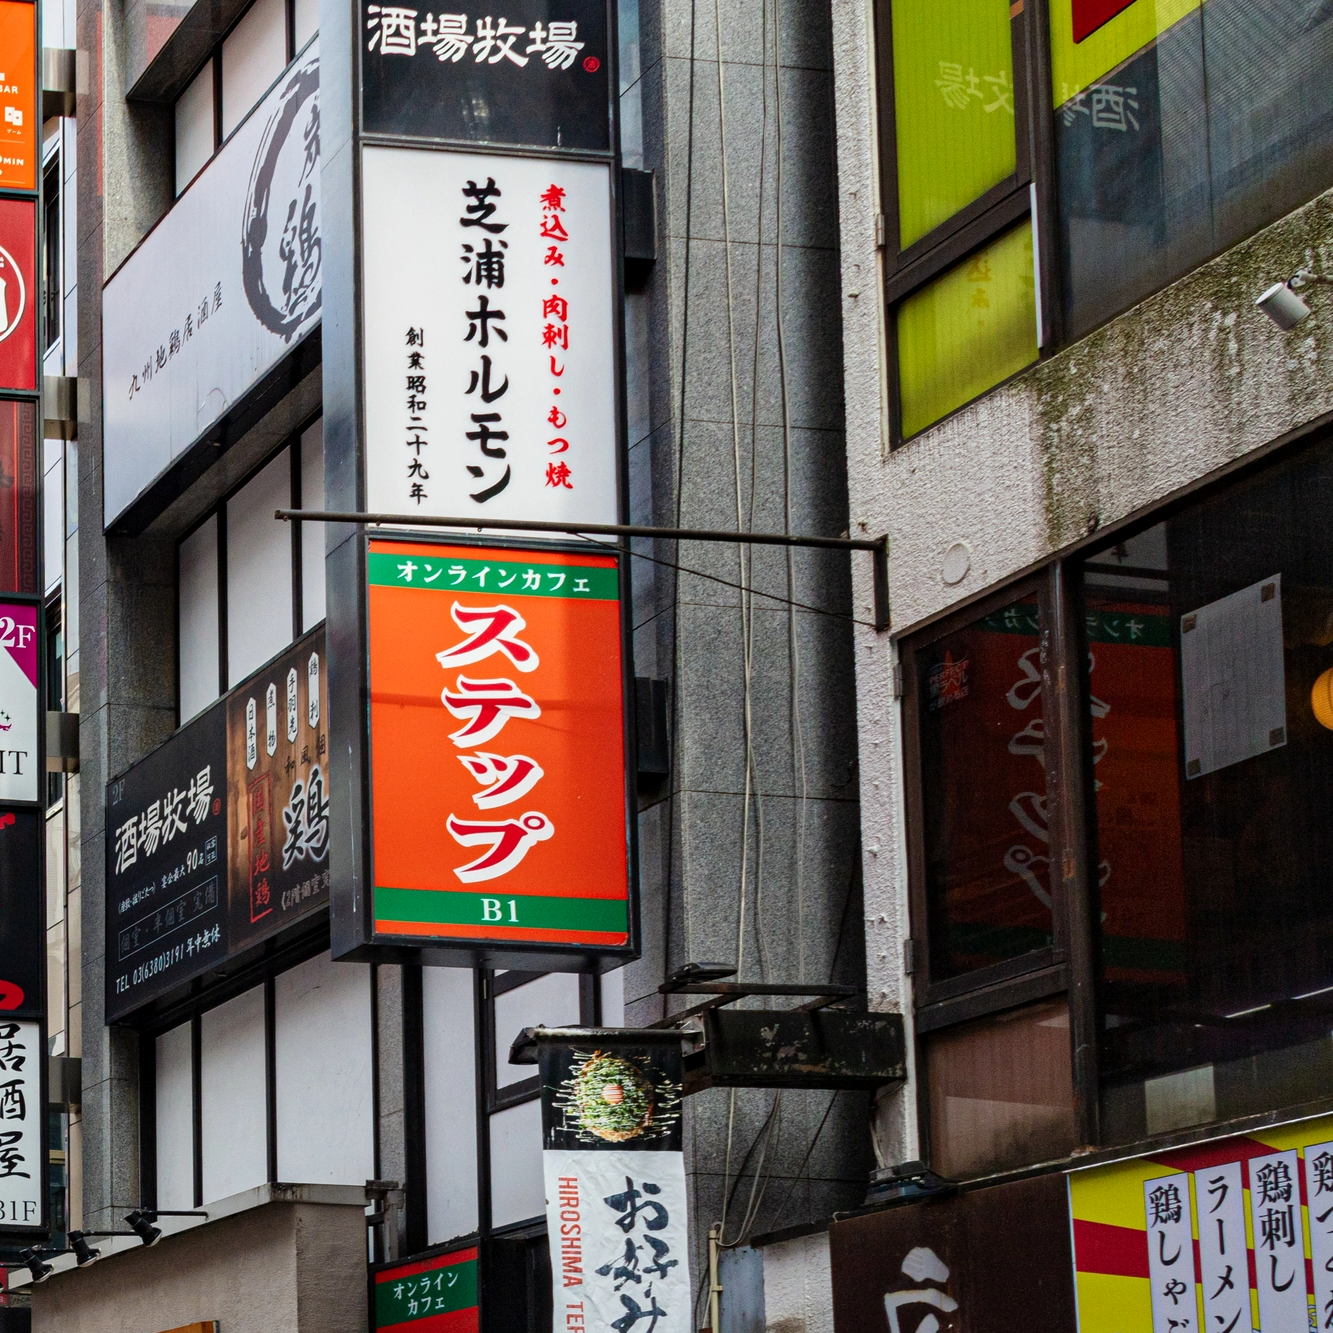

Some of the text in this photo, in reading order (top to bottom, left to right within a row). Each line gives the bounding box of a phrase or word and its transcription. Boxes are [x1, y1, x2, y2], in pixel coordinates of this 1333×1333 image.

[367, 3, 585, 71] 酒場牧場
[459, 176, 510, 504] 芝浦ホルモン
[404, 326, 429, 505] 創業昭和二十九年
[396, 560, 591, 593] オンラインカフェ
[435, 600, 555, 884] ステップ
[115, 765, 214, 876] 酒場牧場
[481, 898, 519, 924] B1
[116, 977, 130, 995] TEL
[1256, 1162, 1296, 1292] 鶏刺し
[392, 1268, 459, 1301] オンライン
[406, 1295, 445, 1317] カフェ
